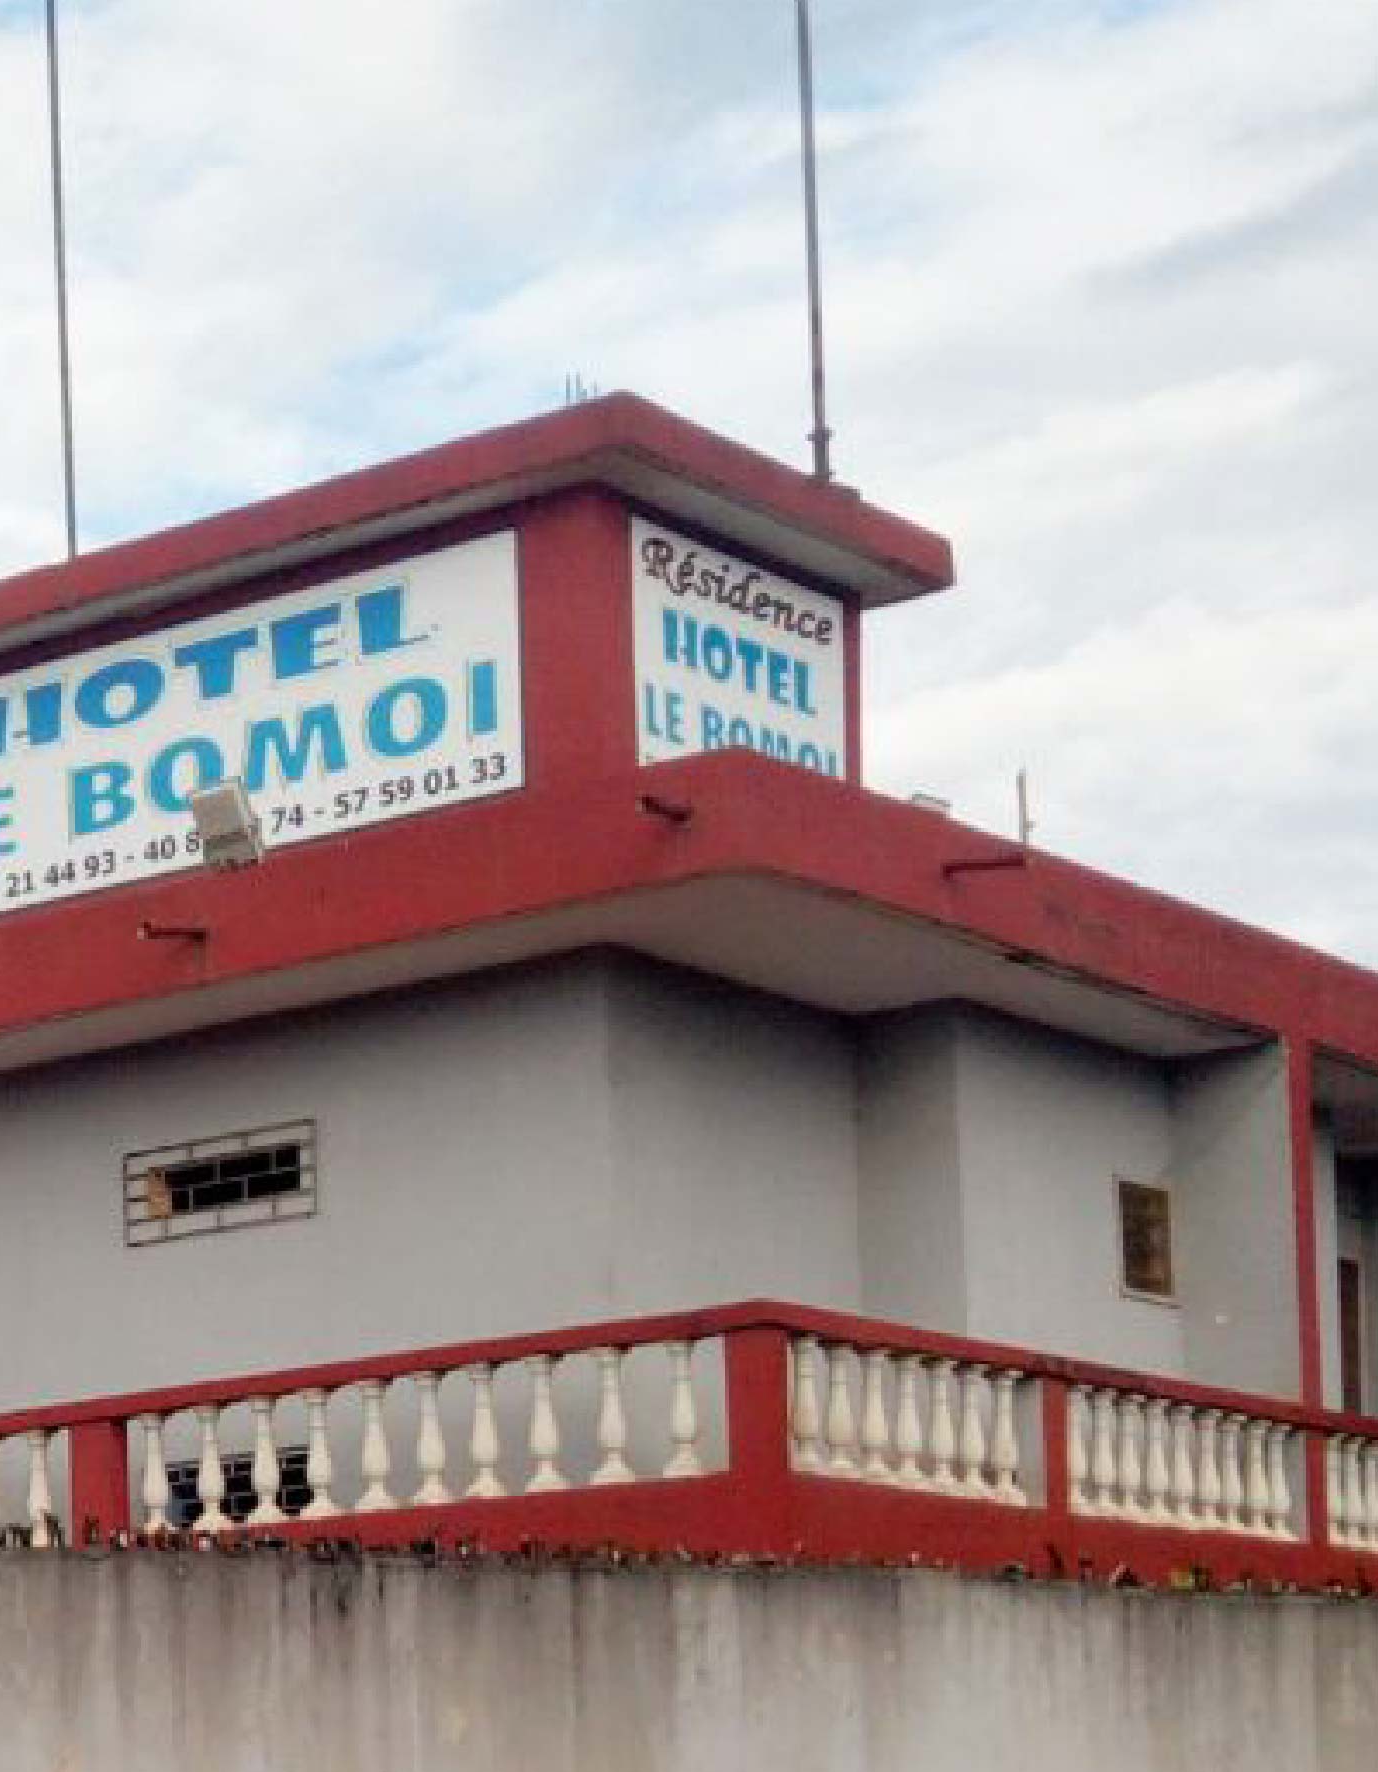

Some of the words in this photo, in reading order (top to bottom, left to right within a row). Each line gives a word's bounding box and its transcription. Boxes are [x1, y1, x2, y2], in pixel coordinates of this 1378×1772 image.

[642, 537, 834, 646] Résidence
[645, 683, 685, 745] LE
[662, 608, 816, 717] HOTEL
[69, 661, 499, 836] BOMOI
[5, 871, 34, 898] 21
[45, 858, 76, 887] 44
[84, 849, 116, 877] 93
[144, 834, 176, 862] 40
[270, 804, 304, 834] 74
[334, 787, 370, 818] 57
[379, 775, 415, 807] 59
[424, 765, 460, 795] 01
[469, 752, 507, 784] 33
